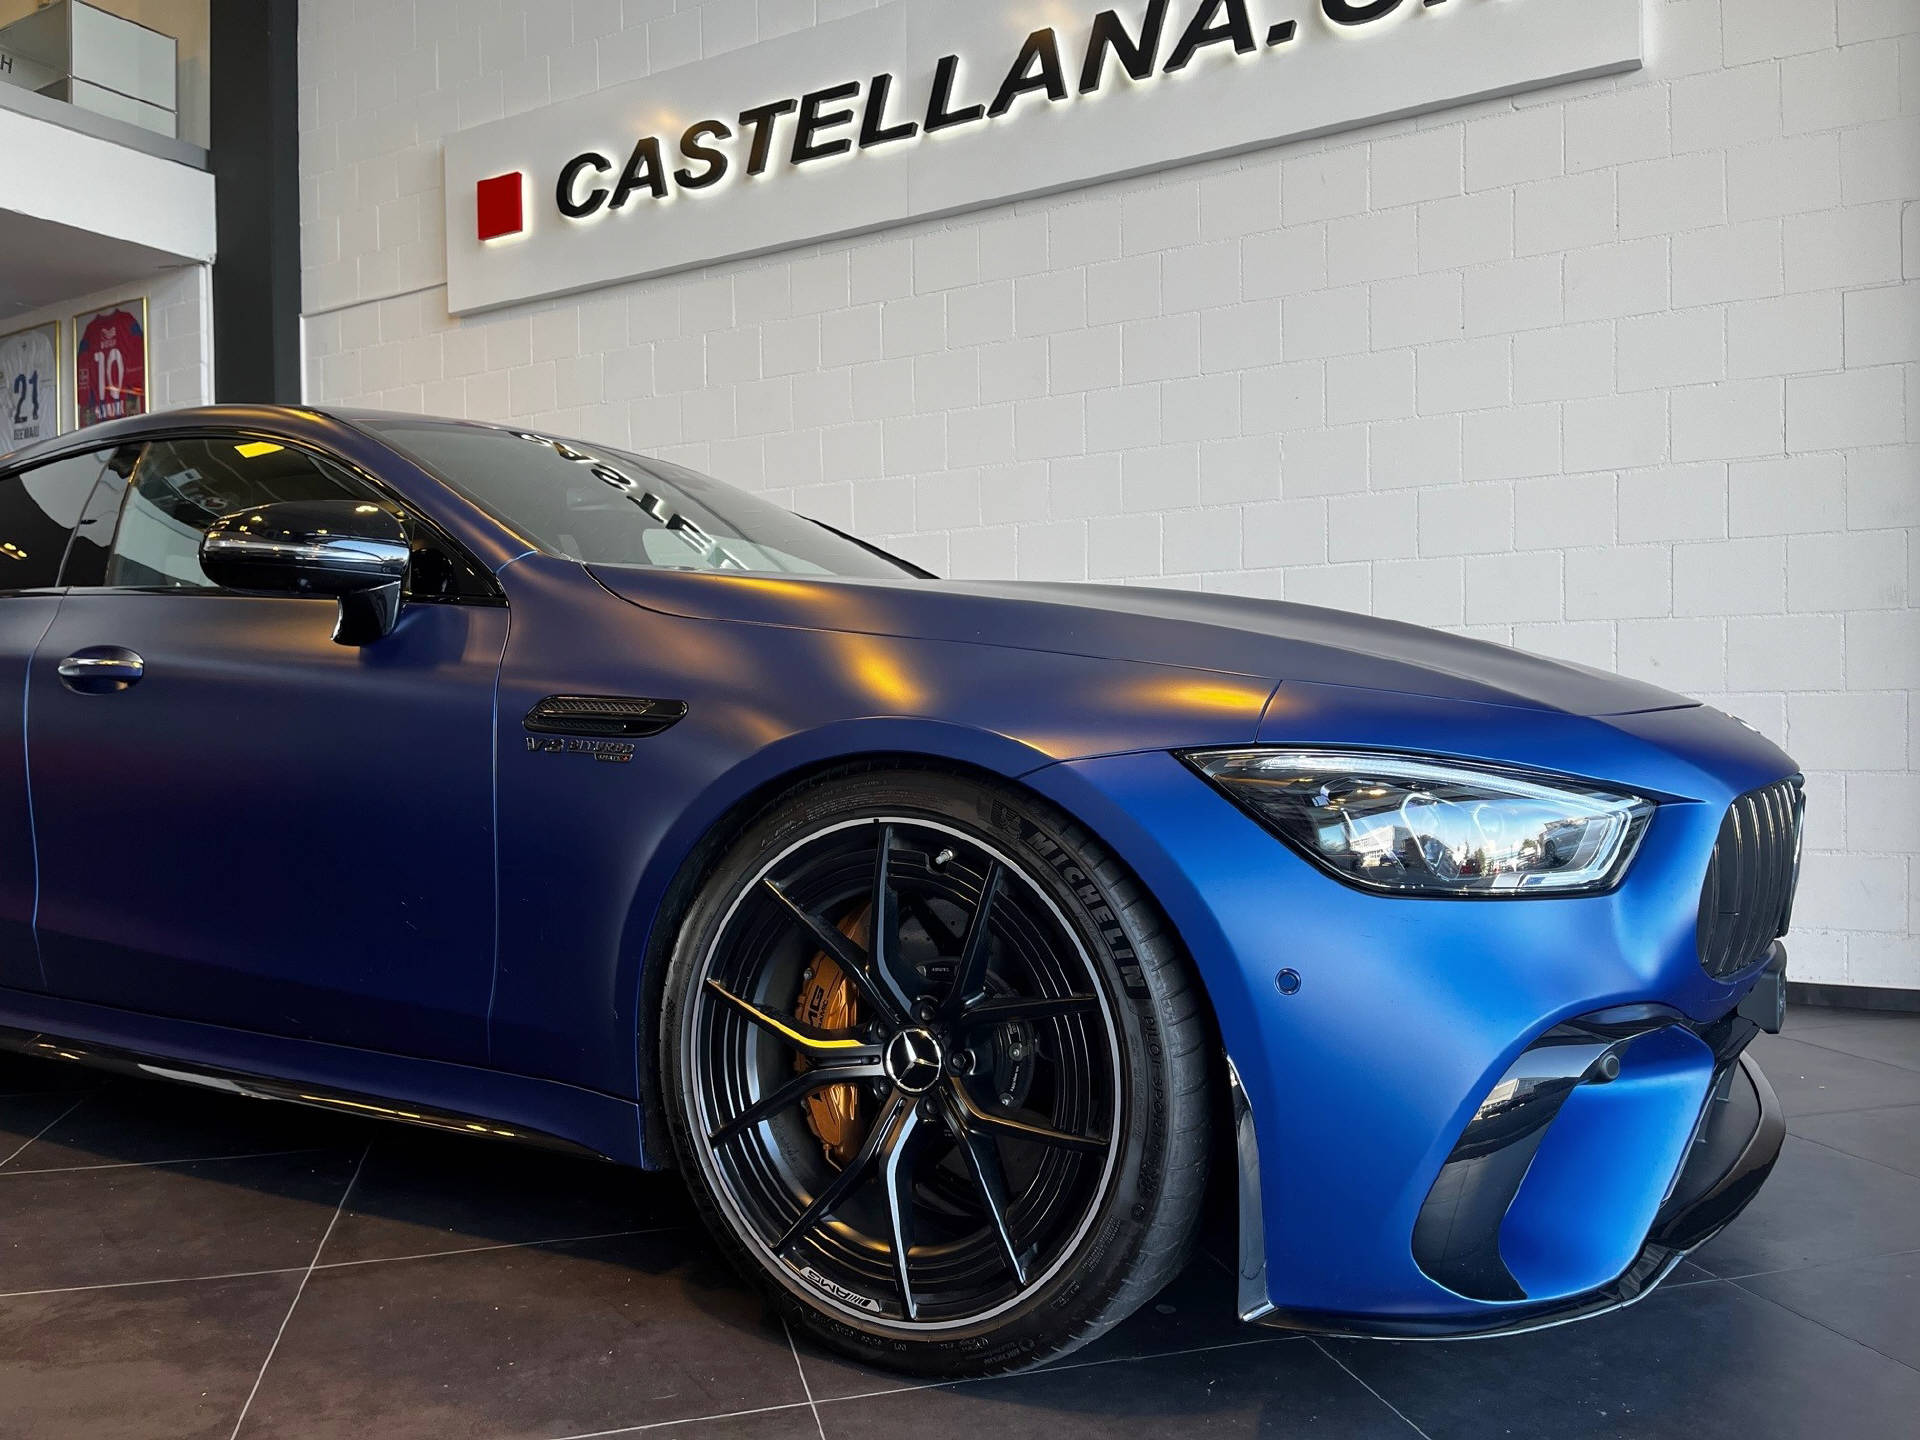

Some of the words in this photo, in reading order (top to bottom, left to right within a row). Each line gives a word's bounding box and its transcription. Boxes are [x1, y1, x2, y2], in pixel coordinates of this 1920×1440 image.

[14, 370, 39, 424] 21
[94, 348, 125, 401] 10
[1026, 831, 1146, 988] MICHELIN
[1144, 1015, 1162, 1070] PILOT
[1151, 1078, 1164, 1137] SPORT
